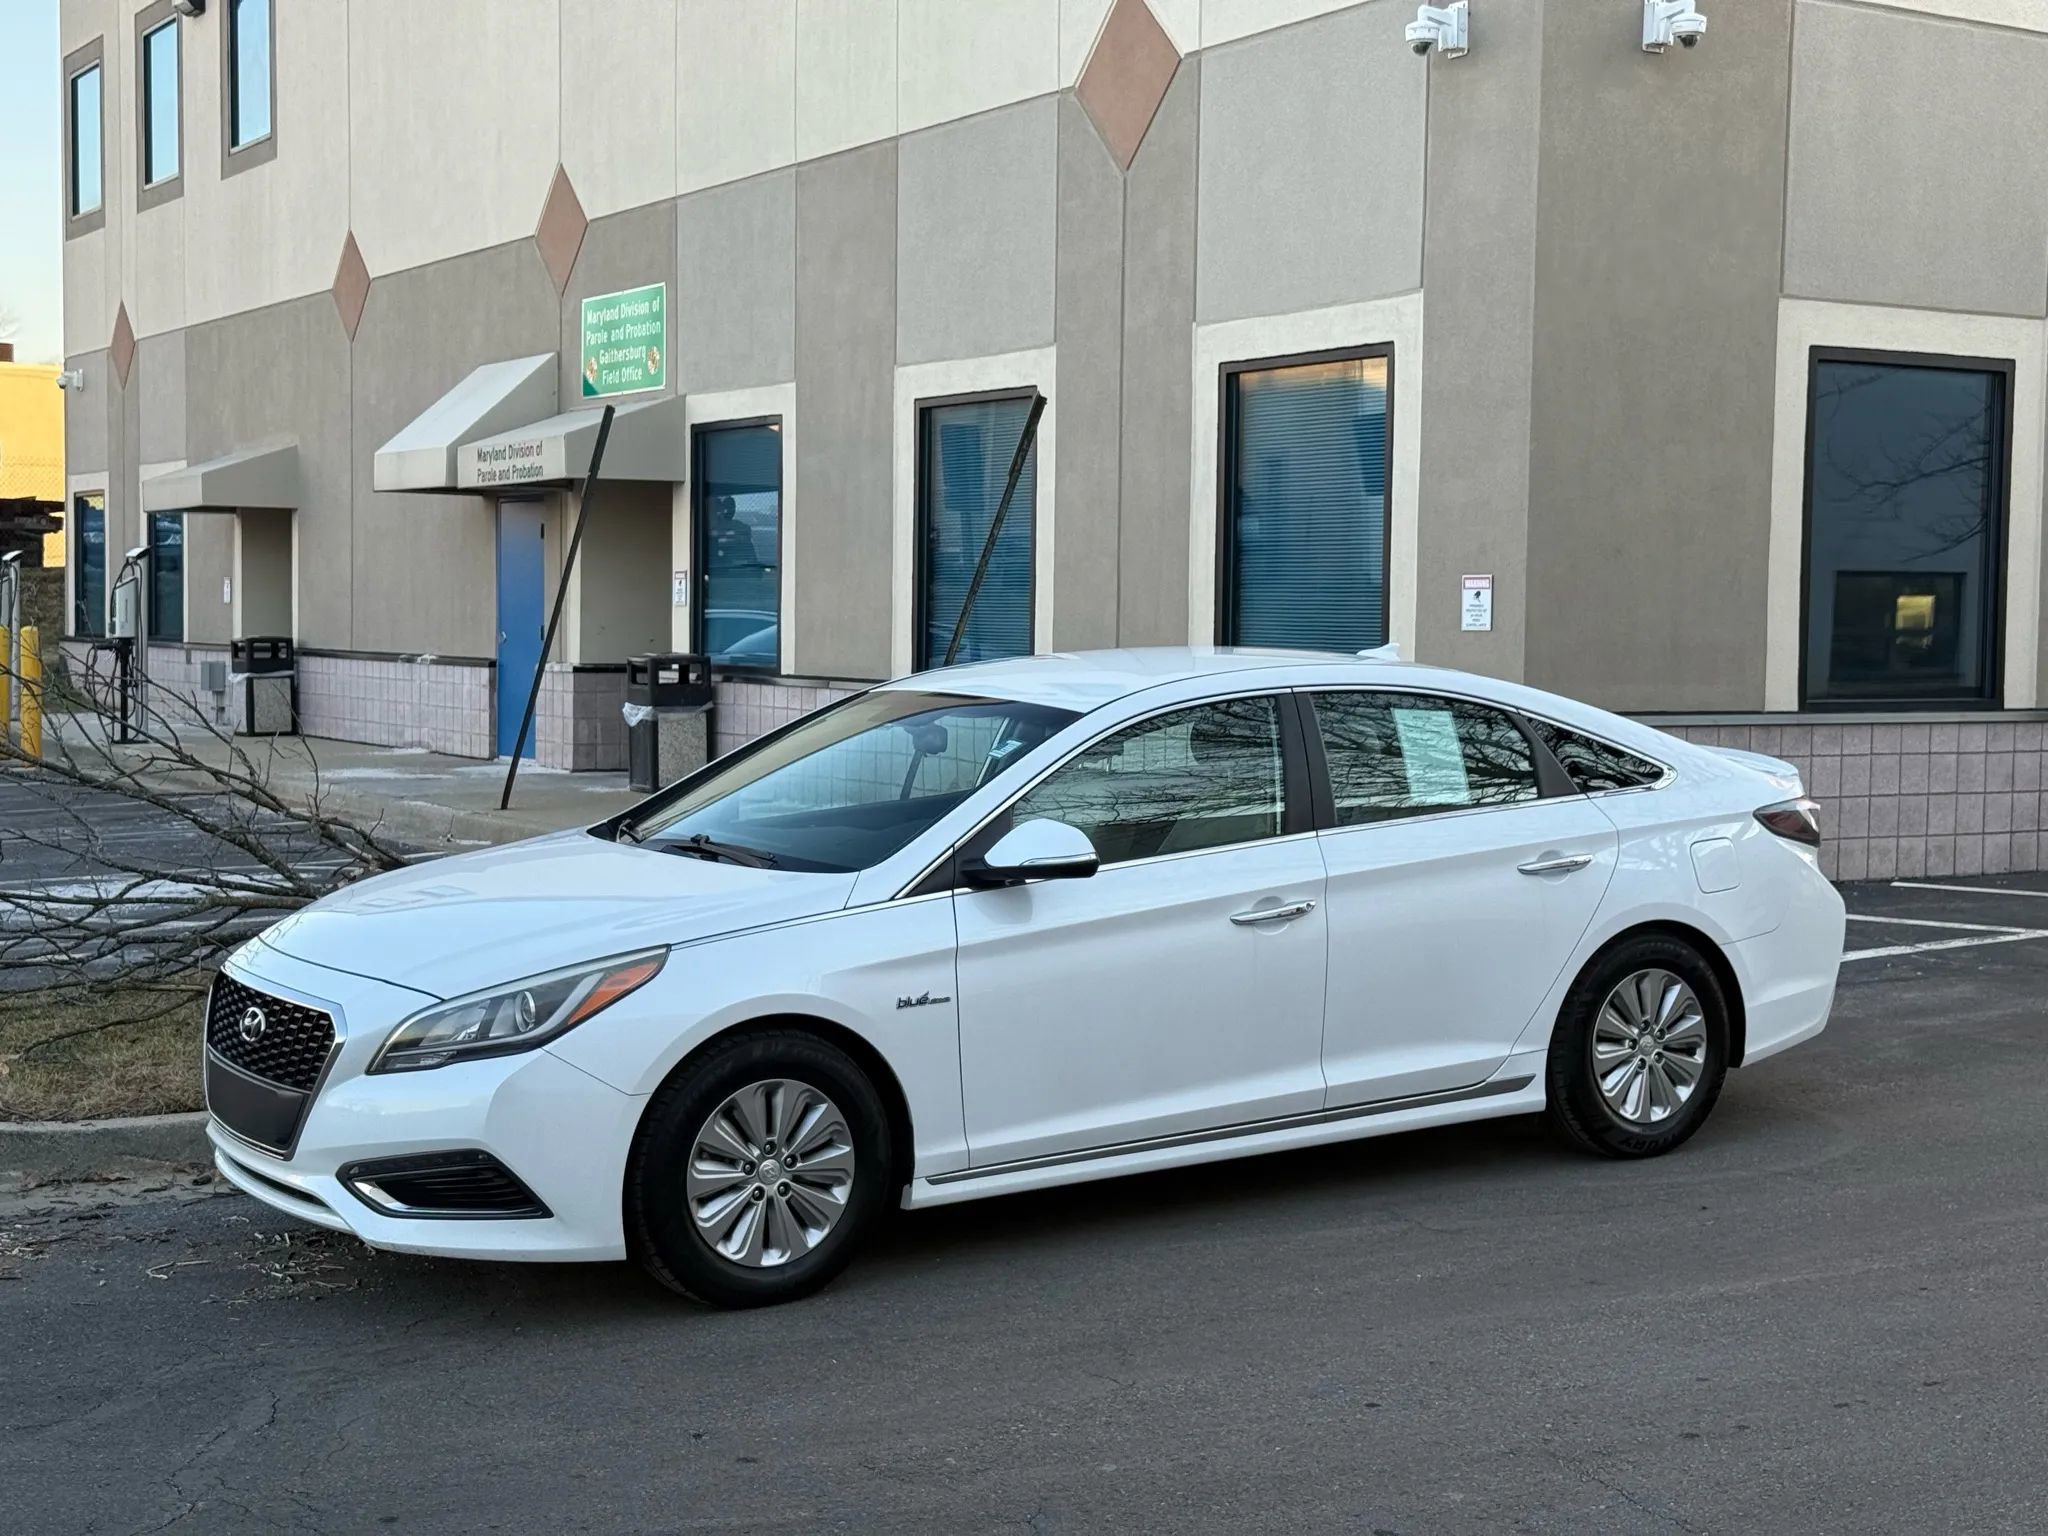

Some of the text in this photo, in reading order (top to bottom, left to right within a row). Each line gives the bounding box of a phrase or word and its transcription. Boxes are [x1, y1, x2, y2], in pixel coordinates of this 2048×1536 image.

[587, 296, 660, 326] Maryland Division of
[586, 319, 661, 346] Parole and Probation
[599, 345, 647, 365] Gaithersburg
[602, 366, 643, 385] Field Office
[477, 440, 543, 466] Maryland Division of
[477, 462, 544, 483] Parole and Probation
[896, 993, 929, 1009] blue
